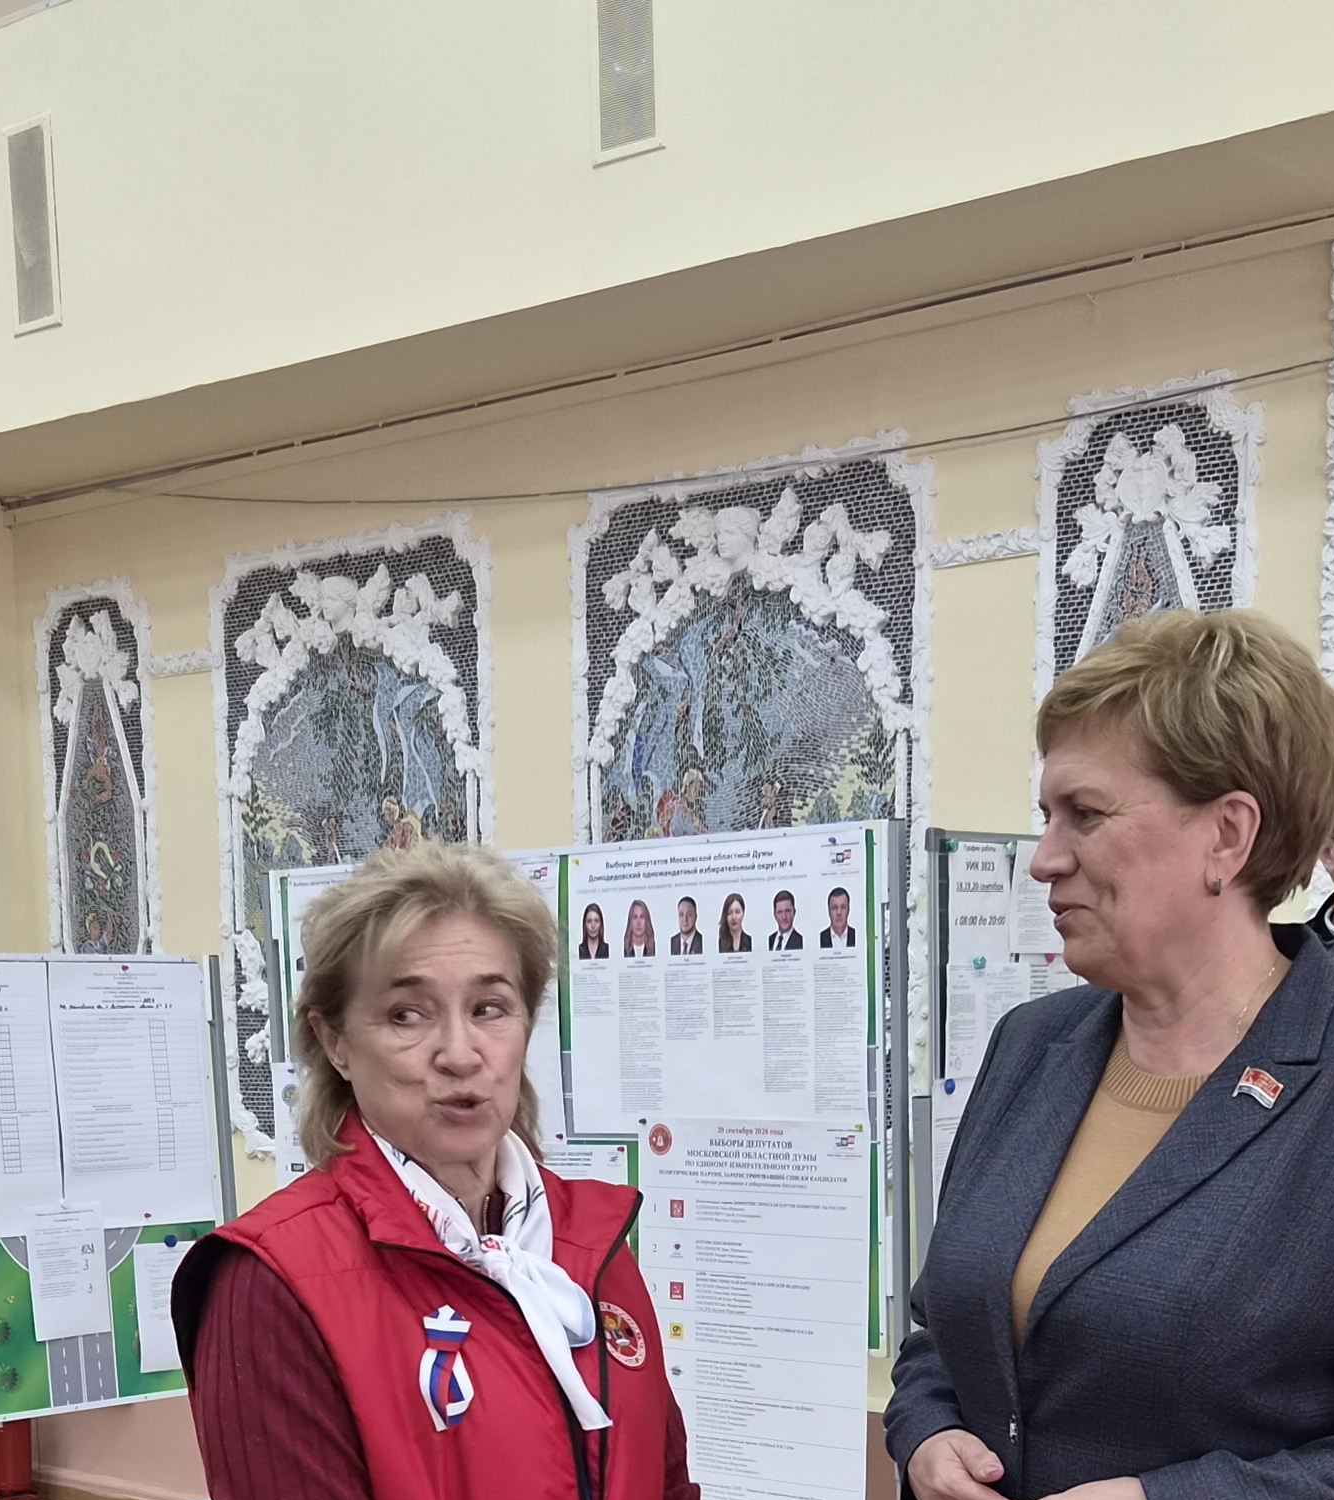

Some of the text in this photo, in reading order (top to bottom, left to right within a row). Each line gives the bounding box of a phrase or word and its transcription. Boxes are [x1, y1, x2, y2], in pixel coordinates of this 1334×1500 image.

[605, 860, 633, 869] Выборы
[669, 854, 712, 864] Московской
[713, 851, 751, 861] областной
[752, 849, 773, 859] Думы
[699, 863, 755, 875] избирательный
[757, 861, 777, 871] округ
[788, 859, 793, 867] 4
[965, 861, 979, 871] УИК
[980, 883, 1004, 892] сентября
[978, 916, 987, 926] до
[988, 916, 1006, 926] 20:00
[717, 1126, 725, 1134] 20
[725, 1127, 753, 1136] сентября
[709, 1138, 793, 1149] ВЫБОРЫ ДЕПУТАТОВ
[686, 1149, 818, 1162] МОСКОВСКОЙ ОБЛАСТНОЙ ДУМЫ
[792, 1164, 819, 1172] ОКРУГУ
[653, 1205, 657, 1213] 1
[652, 1244, 658, 1253] 2
[652, 1283, 658, 1292] 3
